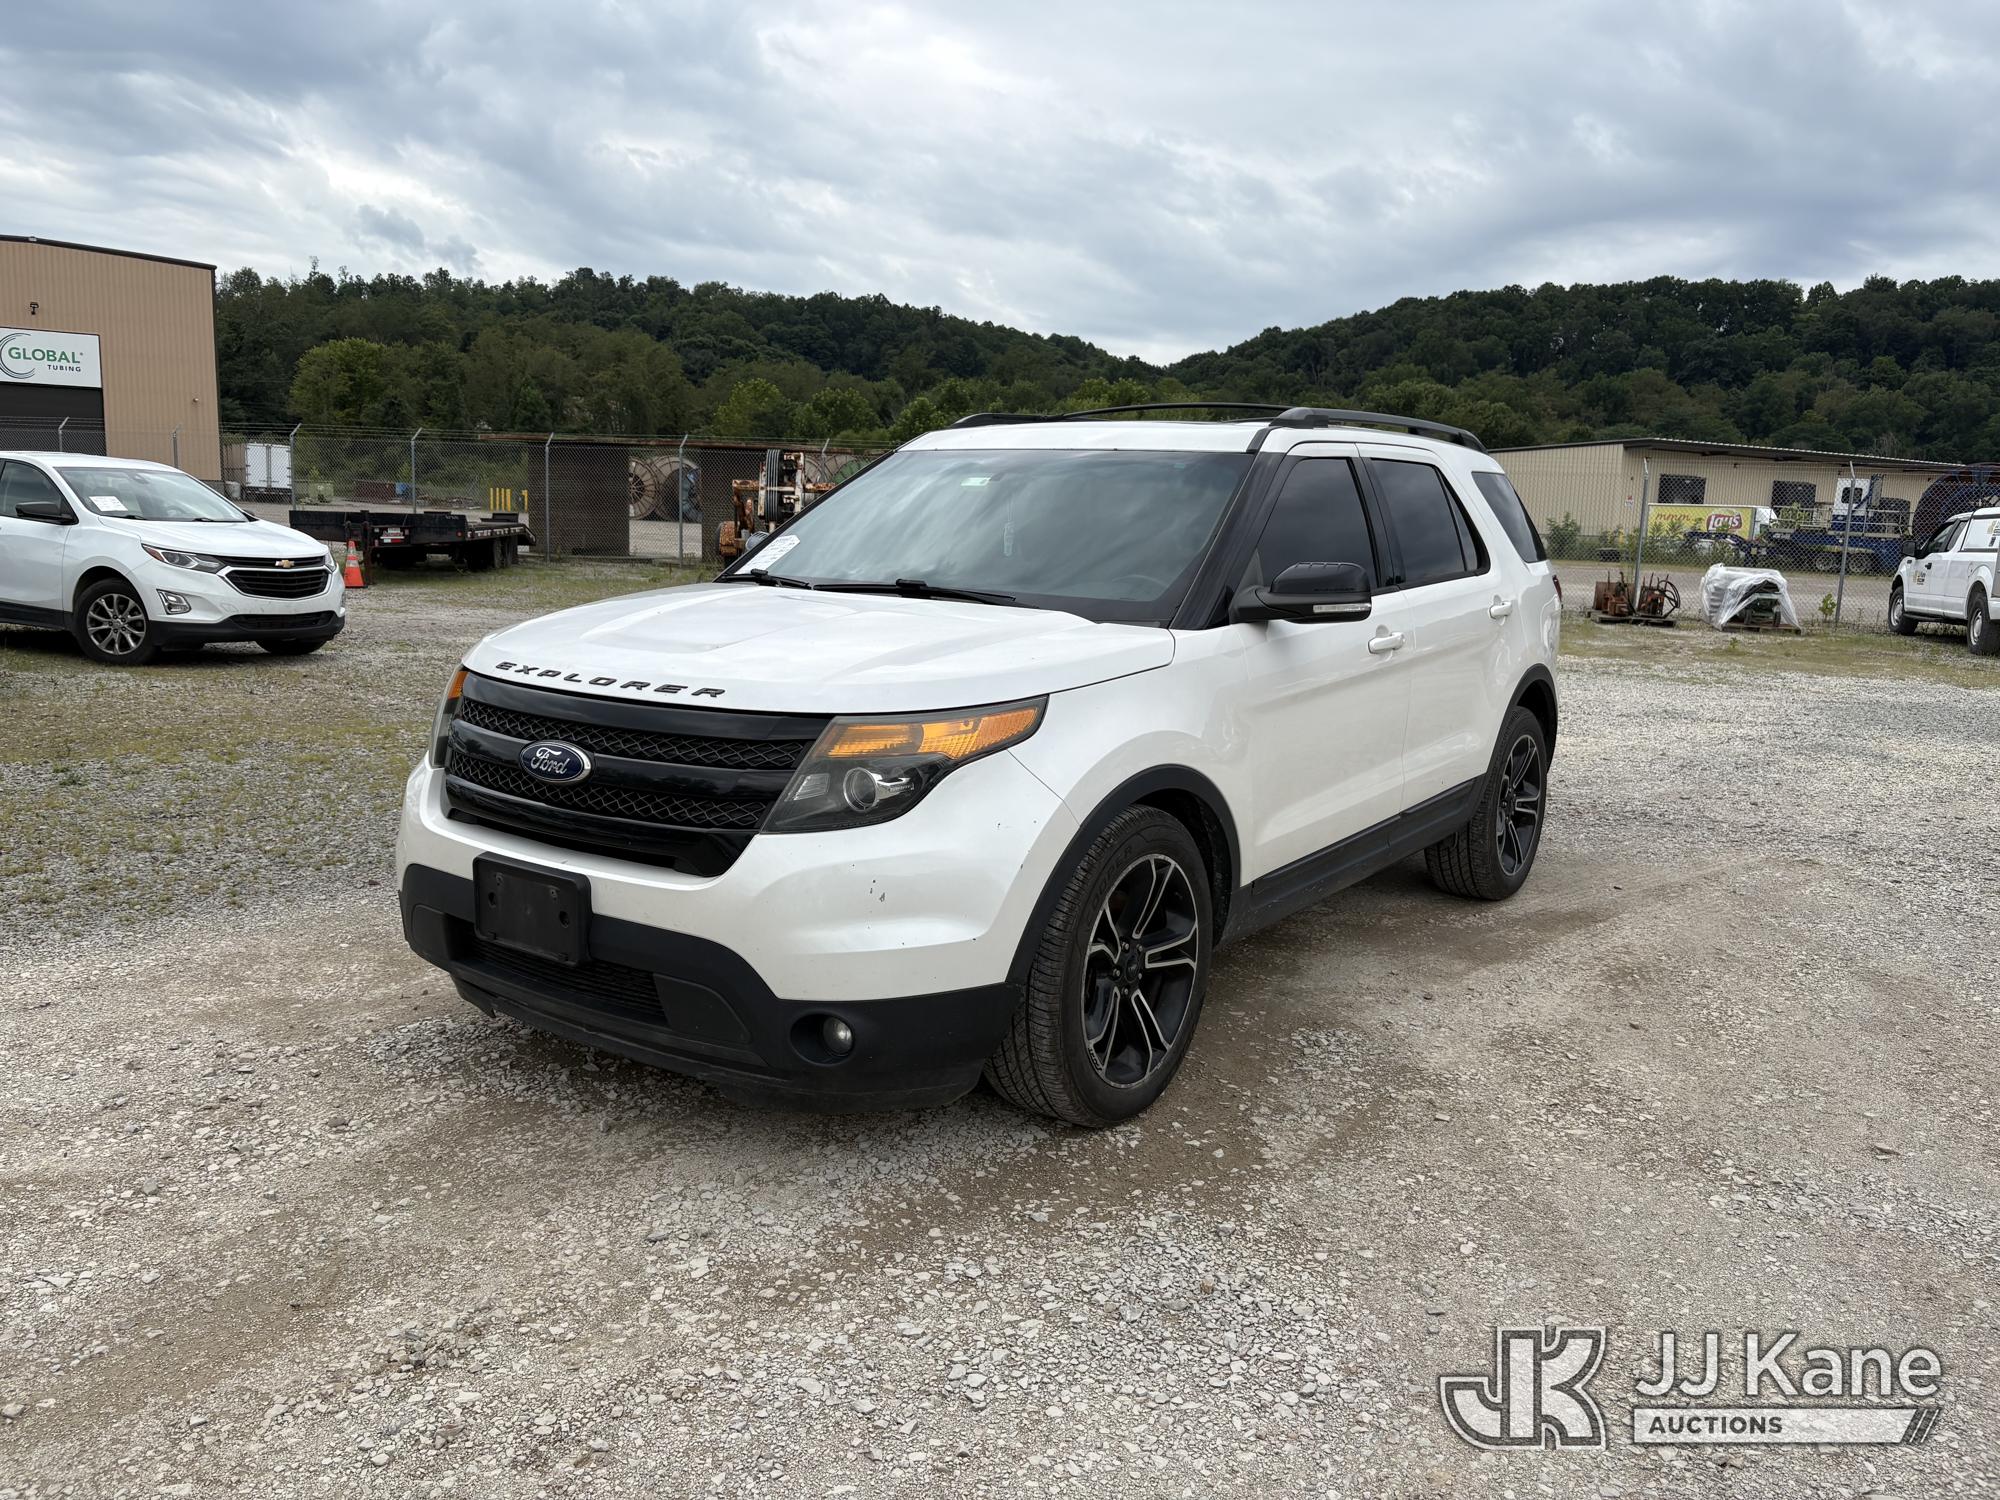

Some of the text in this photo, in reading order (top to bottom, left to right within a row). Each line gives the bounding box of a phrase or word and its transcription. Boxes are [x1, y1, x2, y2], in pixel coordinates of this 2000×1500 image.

[8, 347, 80, 363] GLOBAL
[47, 364, 81, 372] TUBING
[495, 661, 726, 698] EXPLORER
[530, 747, 568, 775] Ford
